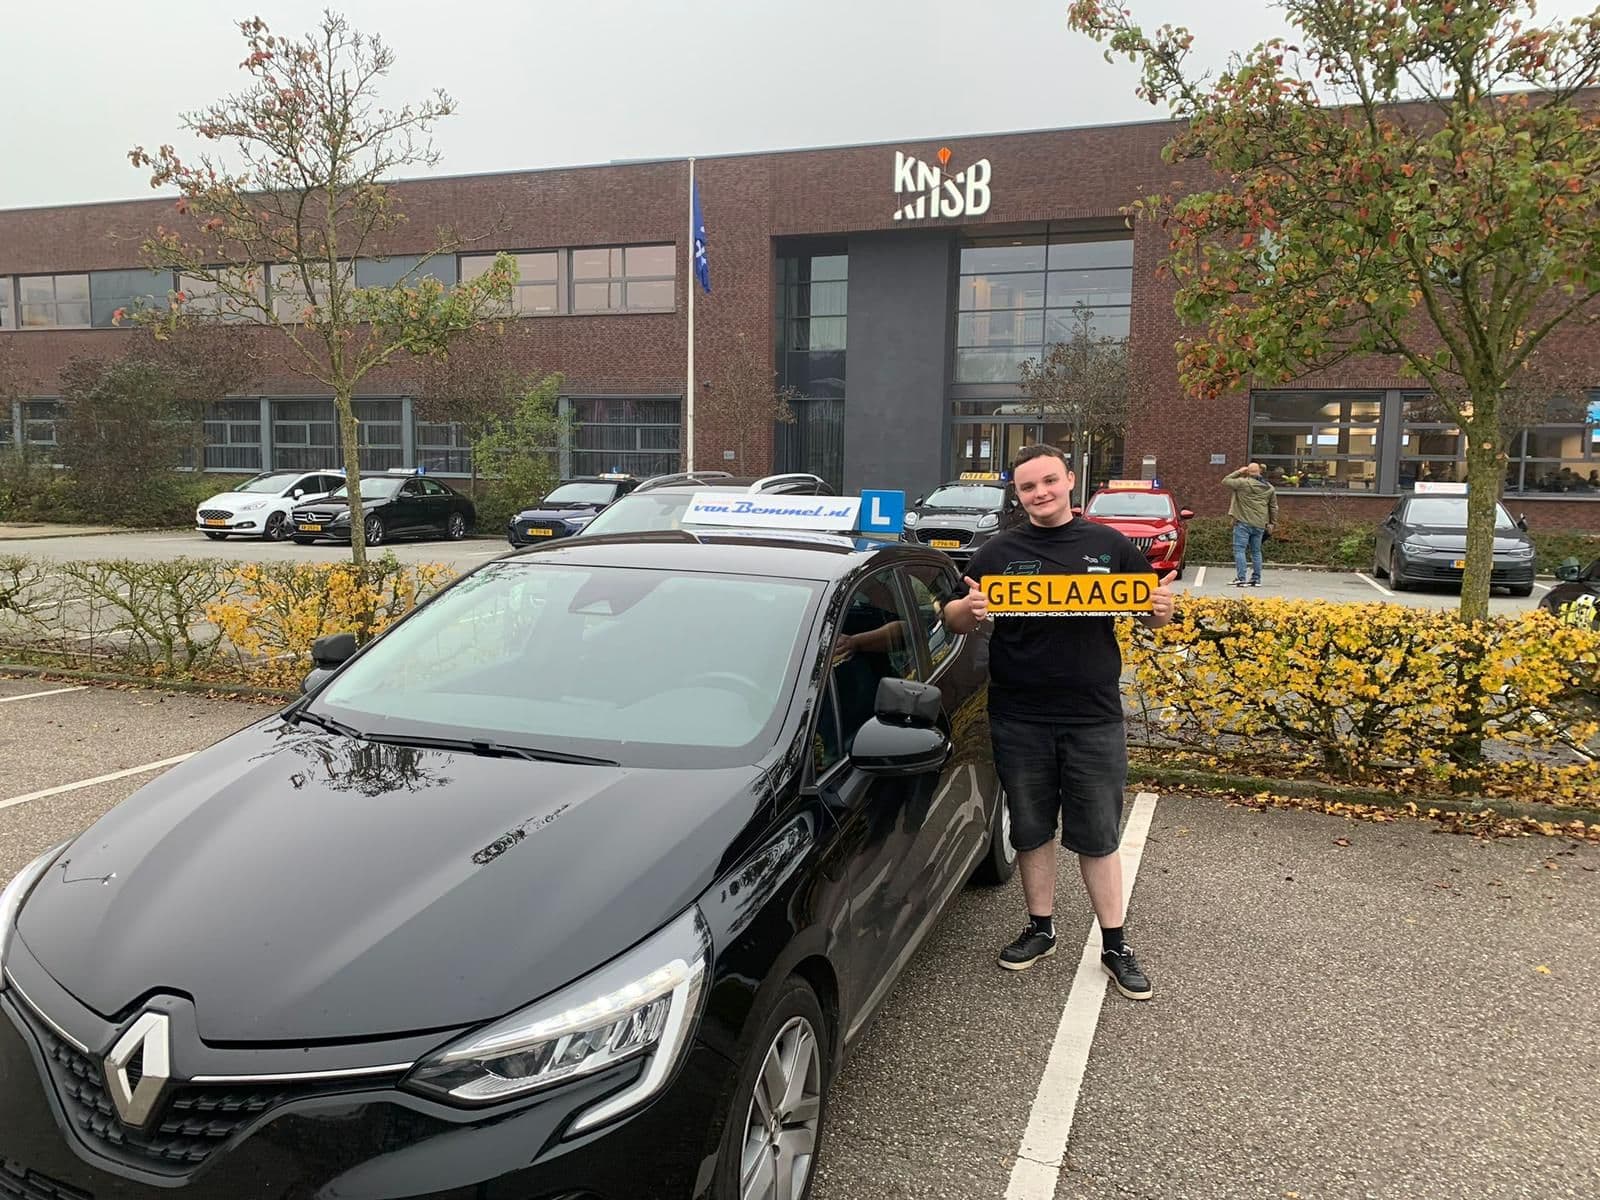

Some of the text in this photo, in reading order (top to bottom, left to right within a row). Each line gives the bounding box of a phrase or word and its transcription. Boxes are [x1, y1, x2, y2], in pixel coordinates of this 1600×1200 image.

[894, 150, 992, 219] KNSB
[871, 497, 891, 525] L
[987, 580, 1151, 605] GESLAAGD
